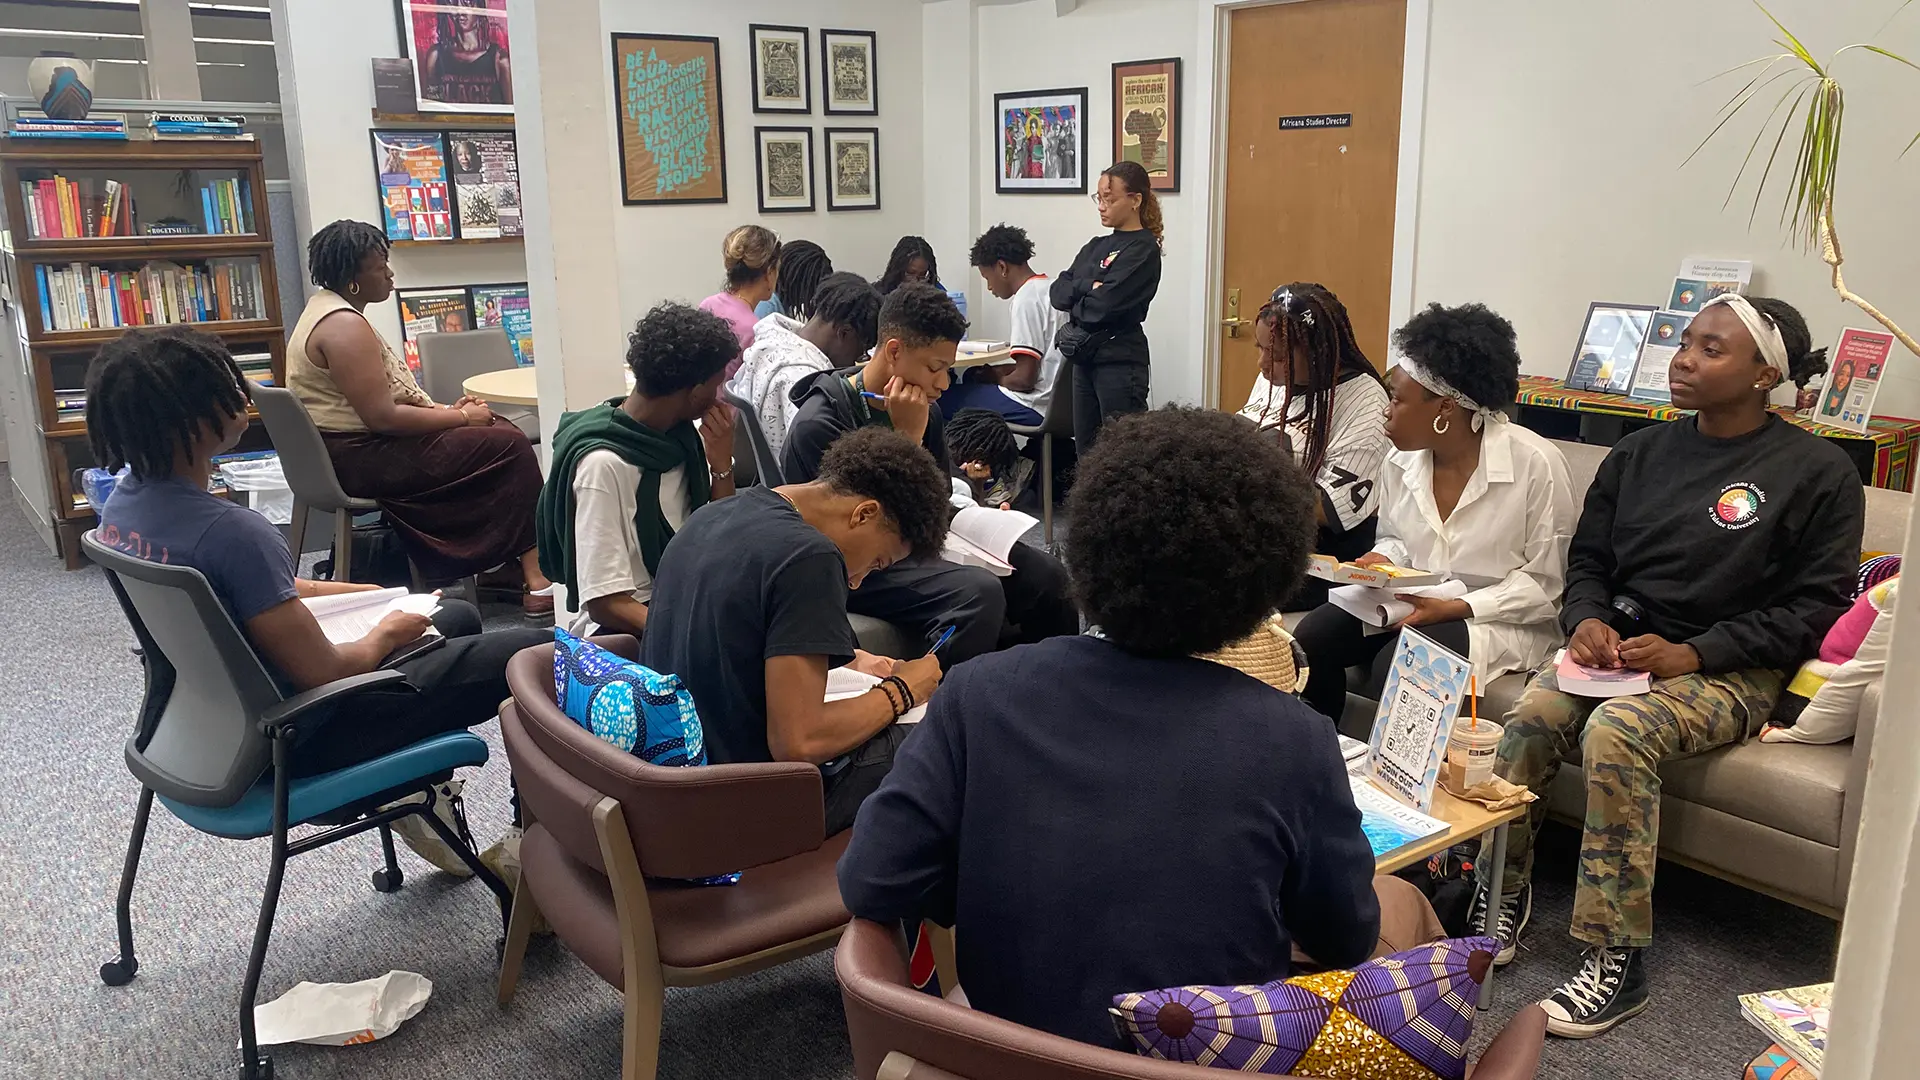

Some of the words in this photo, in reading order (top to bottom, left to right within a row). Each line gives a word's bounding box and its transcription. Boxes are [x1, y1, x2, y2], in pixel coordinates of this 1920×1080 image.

[625, 50, 644, 70] BE
[648, 47, 657, 61] A
[627, 87, 664, 119] VOICE
[666, 67, 707, 100] AGAINST
[628, 56, 706, 102] UNAPOLOGETIC
[1125, 83, 1163, 96] AFRICAN
[638, 88, 697, 135] RACISM
[1140, 94, 1166, 104] STUDIES
[644, 101, 706, 152] VIOLENCE
[1282, 119, 1304, 127] Africana
[1306, 118, 1324, 126] Studies
[1326, 117, 1348, 126] Director
[652, 115, 710, 164] TOWARDS
[659, 135, 708, 176] BLACK
[1721, 482, 1748, 493] Africana
[1748, 482, 1766, 503] Studies
[1710, 511, 1726, 528] Tulane
[1727, 516, 1760, 529] University
[1376, 767, 1415, 802] WAVESYNC!
[1382, 761, 1397, 777] JOIN
[1398, 775, 1414, 790] OUR
